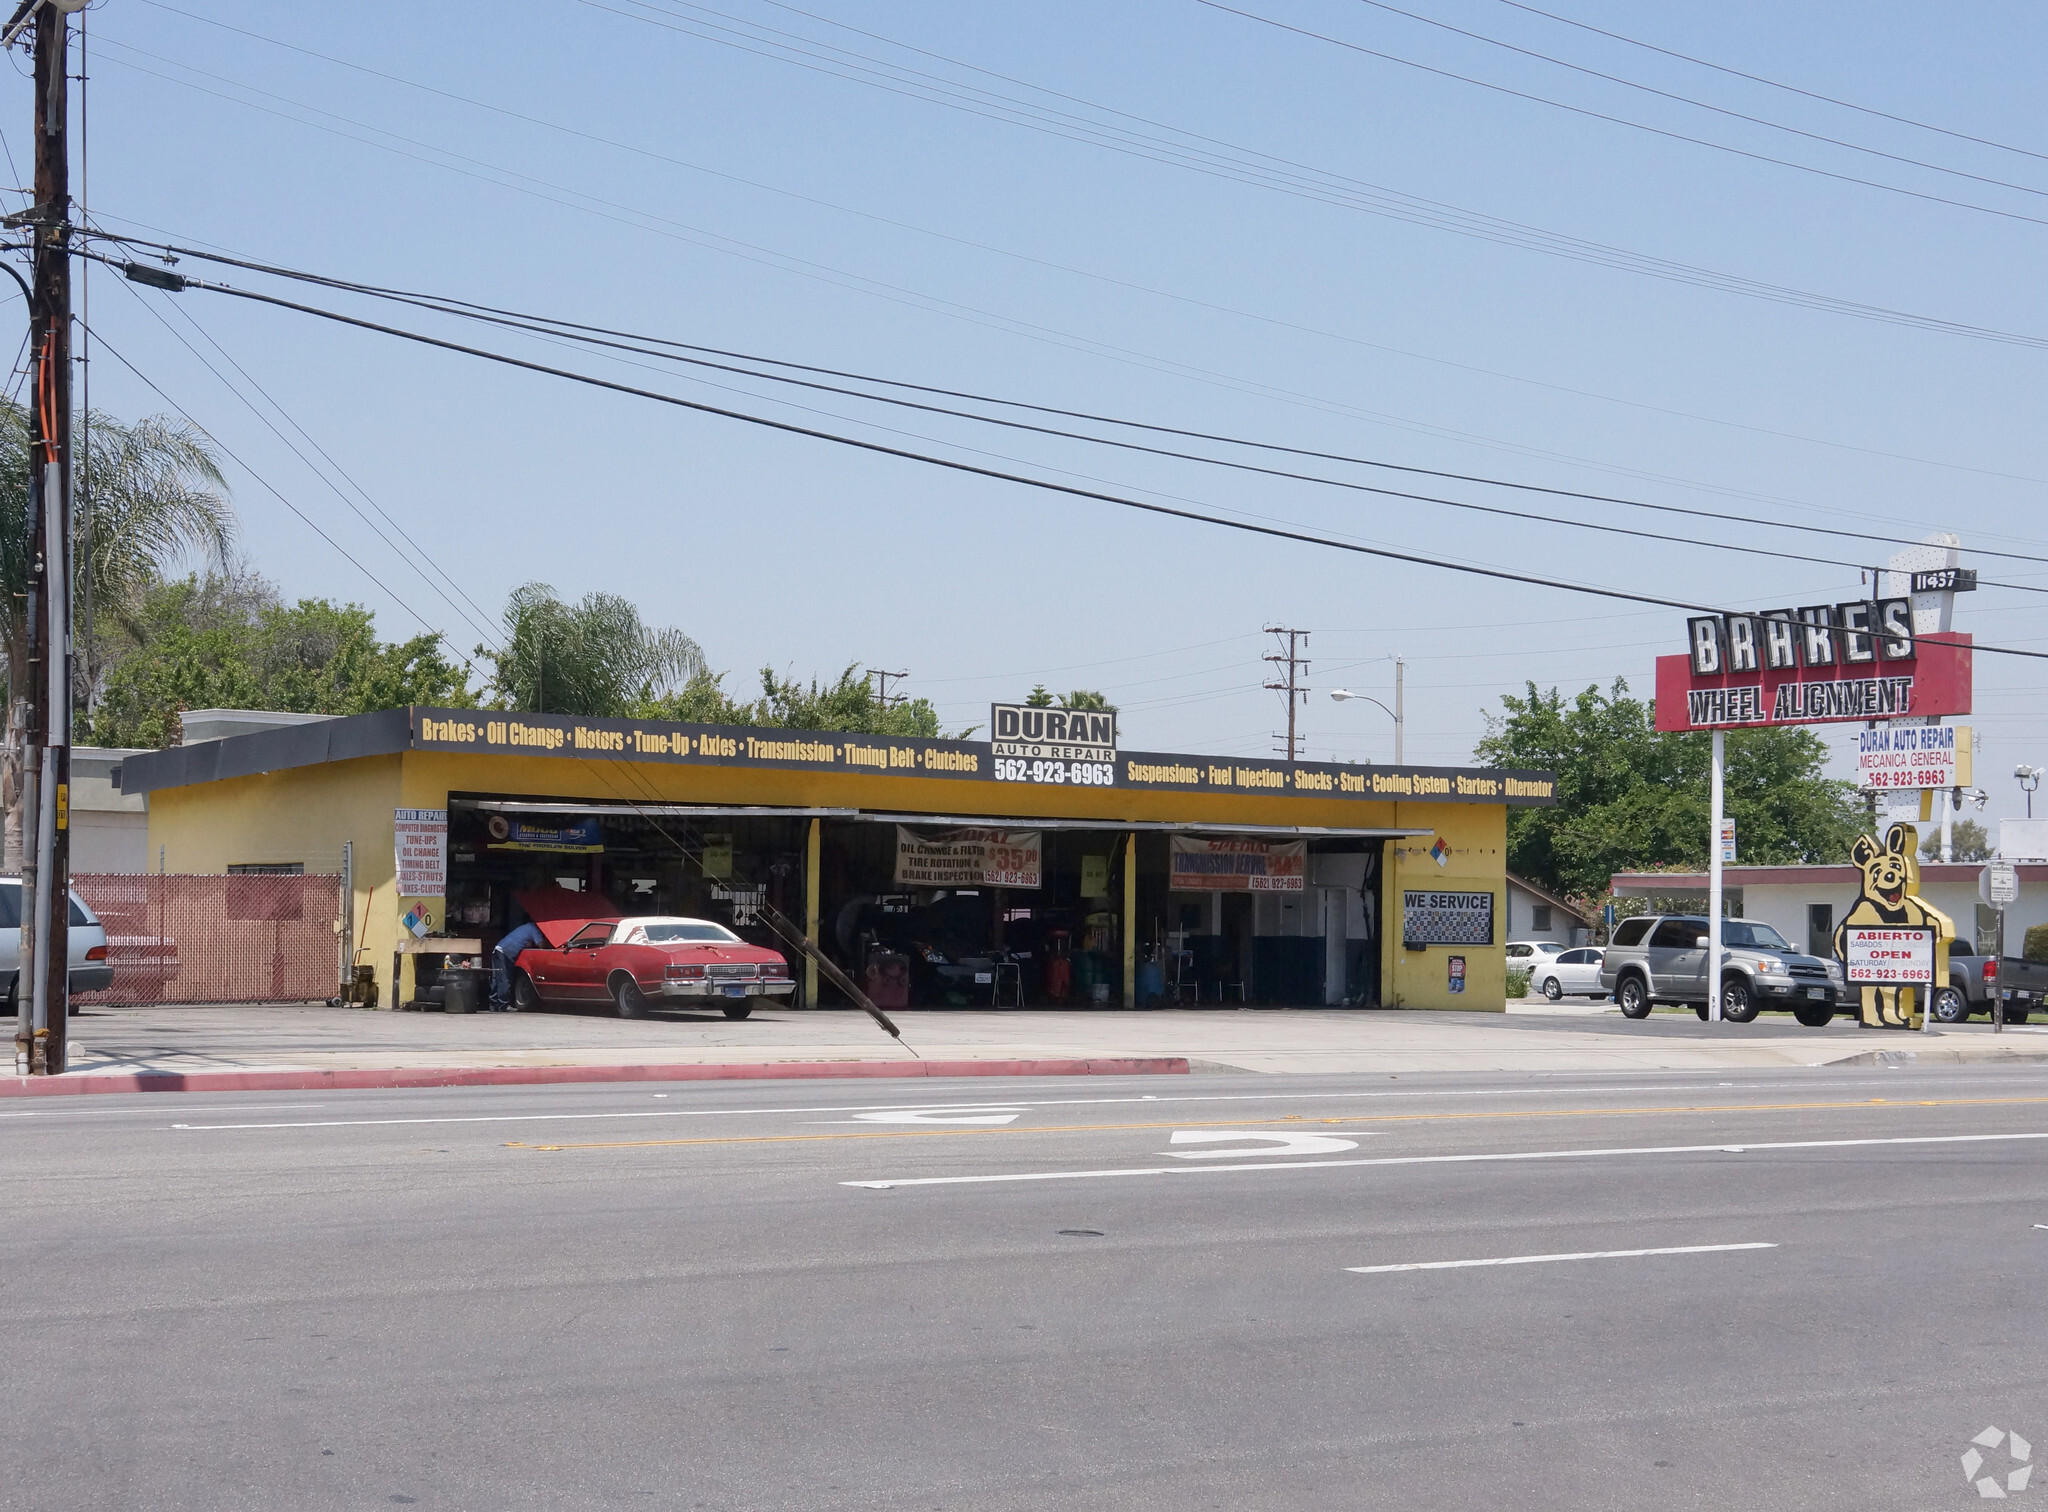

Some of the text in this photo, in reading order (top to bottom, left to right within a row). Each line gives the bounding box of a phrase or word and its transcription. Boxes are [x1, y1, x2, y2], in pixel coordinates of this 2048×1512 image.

[1916, 571, 1956, 591] 11437
[1696, 600, 1913, 673] BRAKES
[1687, 676, 1914, 726] WHEEL ALIGNMENT
[995, 705, 1113, 746] DURAN
[422, 718, 978, 772] Brakes Oil Change Motors Tune-Up Axles Transmission Timing Belt Clutches
[1860, 727, 1954, 752] DURAN AUTO REPAIR
[995, 743, 1113, 761] AUTO REPAIR
[1860, 751, 1954, 768] MECANICA GENERAL
[994, 758, 1114, 785] 562-923-6963
[1127, 760, 1553, 798] Suspensions Fuel Injection Shocks Strut Cooling System Starters Alternator
[1869, 770, 1945, 786] 562-923-6963
[395, 810, 447, 820] AUTO REPAIR
[395, 823, 447, 833] COMPUTER DIAGNOSTIC
[406, 835, 437, 845] TUNE-UPS
[402, 847, 439, 857] OIL CHANGE
[901, 843, 914, 853] OIL
[401, 860, 440, 869] TIMING BELT
[908, 857, 928, 867] TIRE
[930, 858, 970, 868] ROTATION
[1174, 853, 1234, 873] TRANSMISSION
[902, 870, 984, 881] BRAKE INSPECTION
[1005, 872, 1038, 884] 923-6963
[1252, 877, 1269, 888] (562)
[1272, 877, 1302, 889] 923-6963
[1405, 894, 1488, 909] WE SERVICE
[416, 905, 421, 914] 1
[425, 914, 431, 926] 0
[1857, 932, 1923, 940] ABIERTO
[1870, 951, 1911, 959] OPEN
[1851, 969, 1930, 979] 562-923-6963
